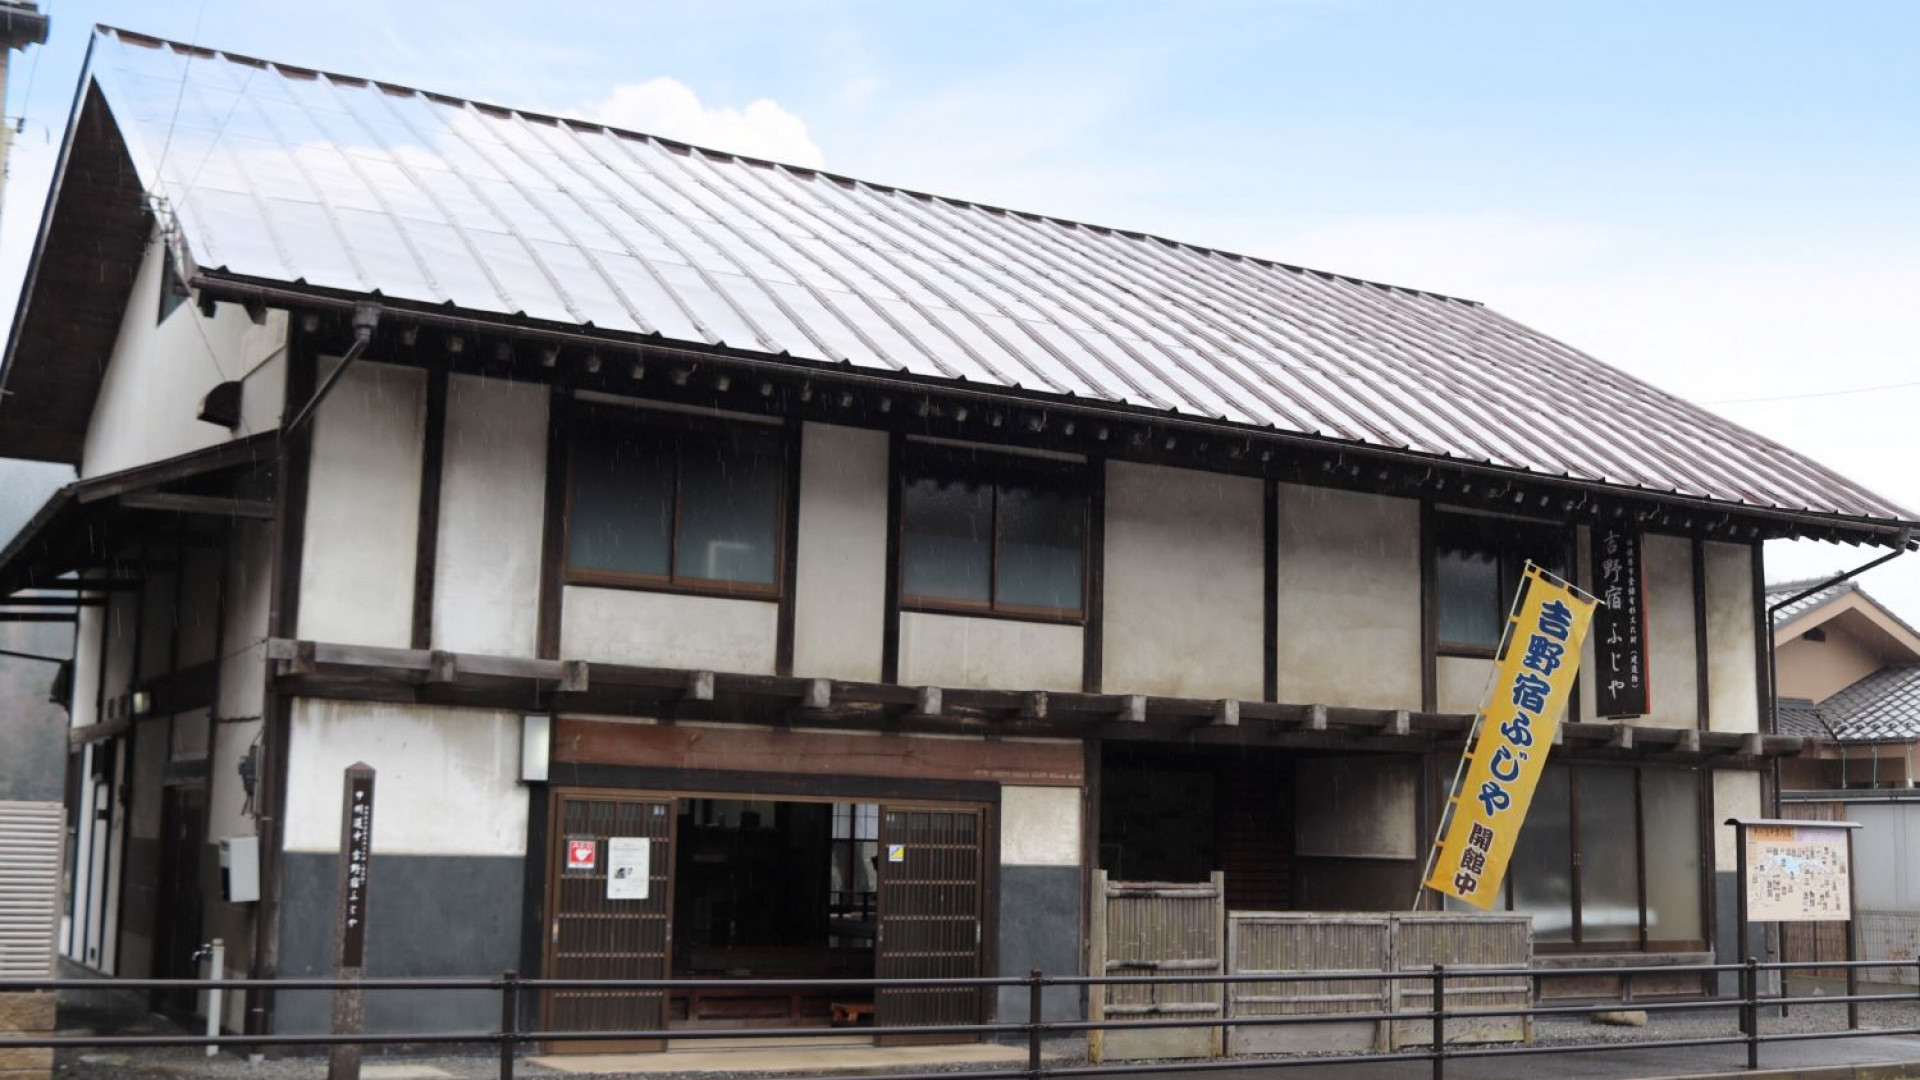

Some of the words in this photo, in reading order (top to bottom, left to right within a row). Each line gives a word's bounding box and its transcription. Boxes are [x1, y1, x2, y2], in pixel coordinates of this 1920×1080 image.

[1478, 599, 1573, 817] 吉野宿ふじや
[1454, 822, 1495, 896] 開館中
